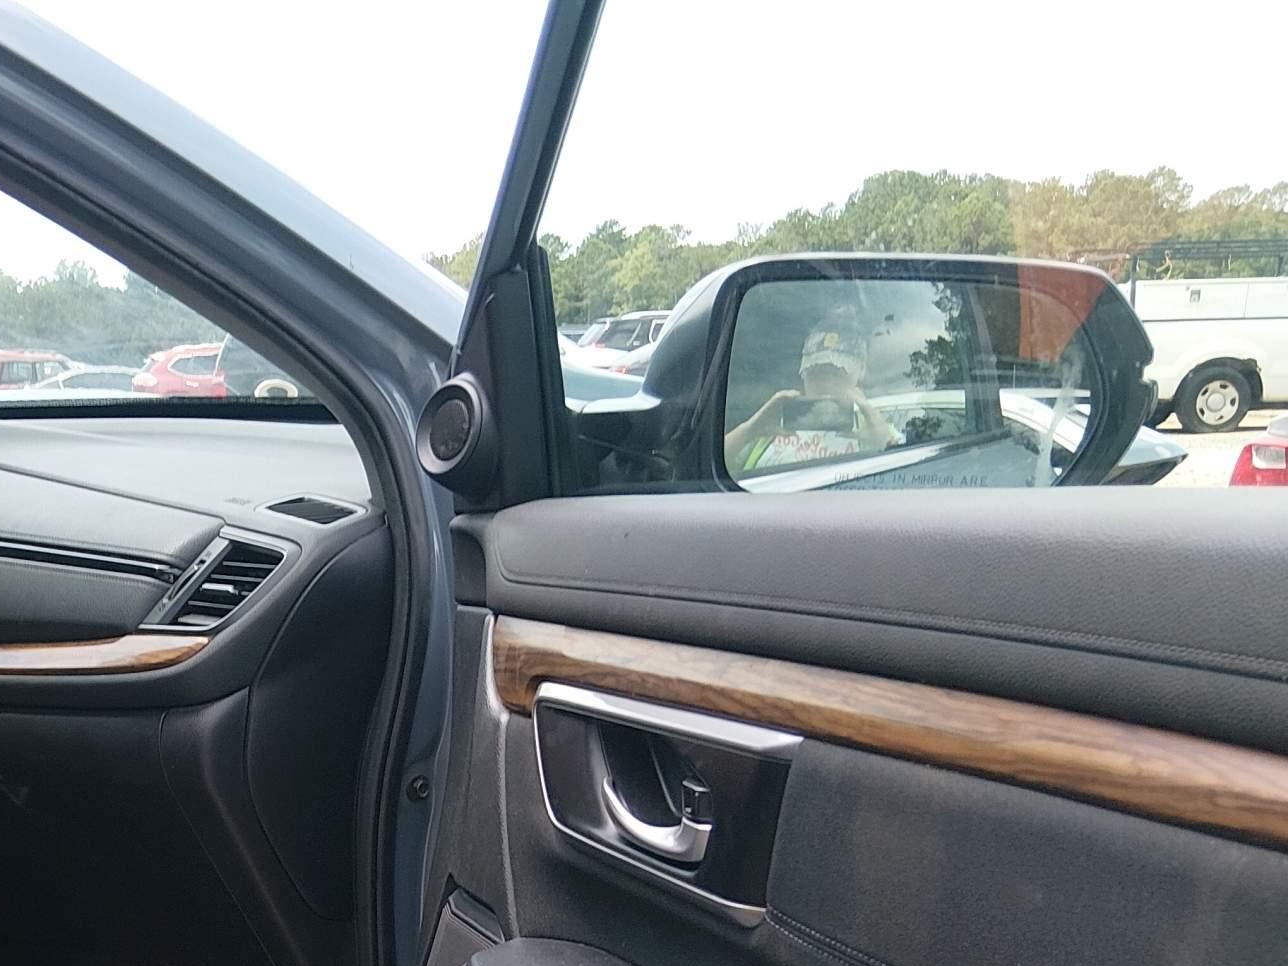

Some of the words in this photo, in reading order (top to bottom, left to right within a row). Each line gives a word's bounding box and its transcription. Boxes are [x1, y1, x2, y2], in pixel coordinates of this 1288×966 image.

[892, 472, 906, 484] IN
[911, 473, 954, 486] MIRROR
[960, 475, 989, 487] ARE
